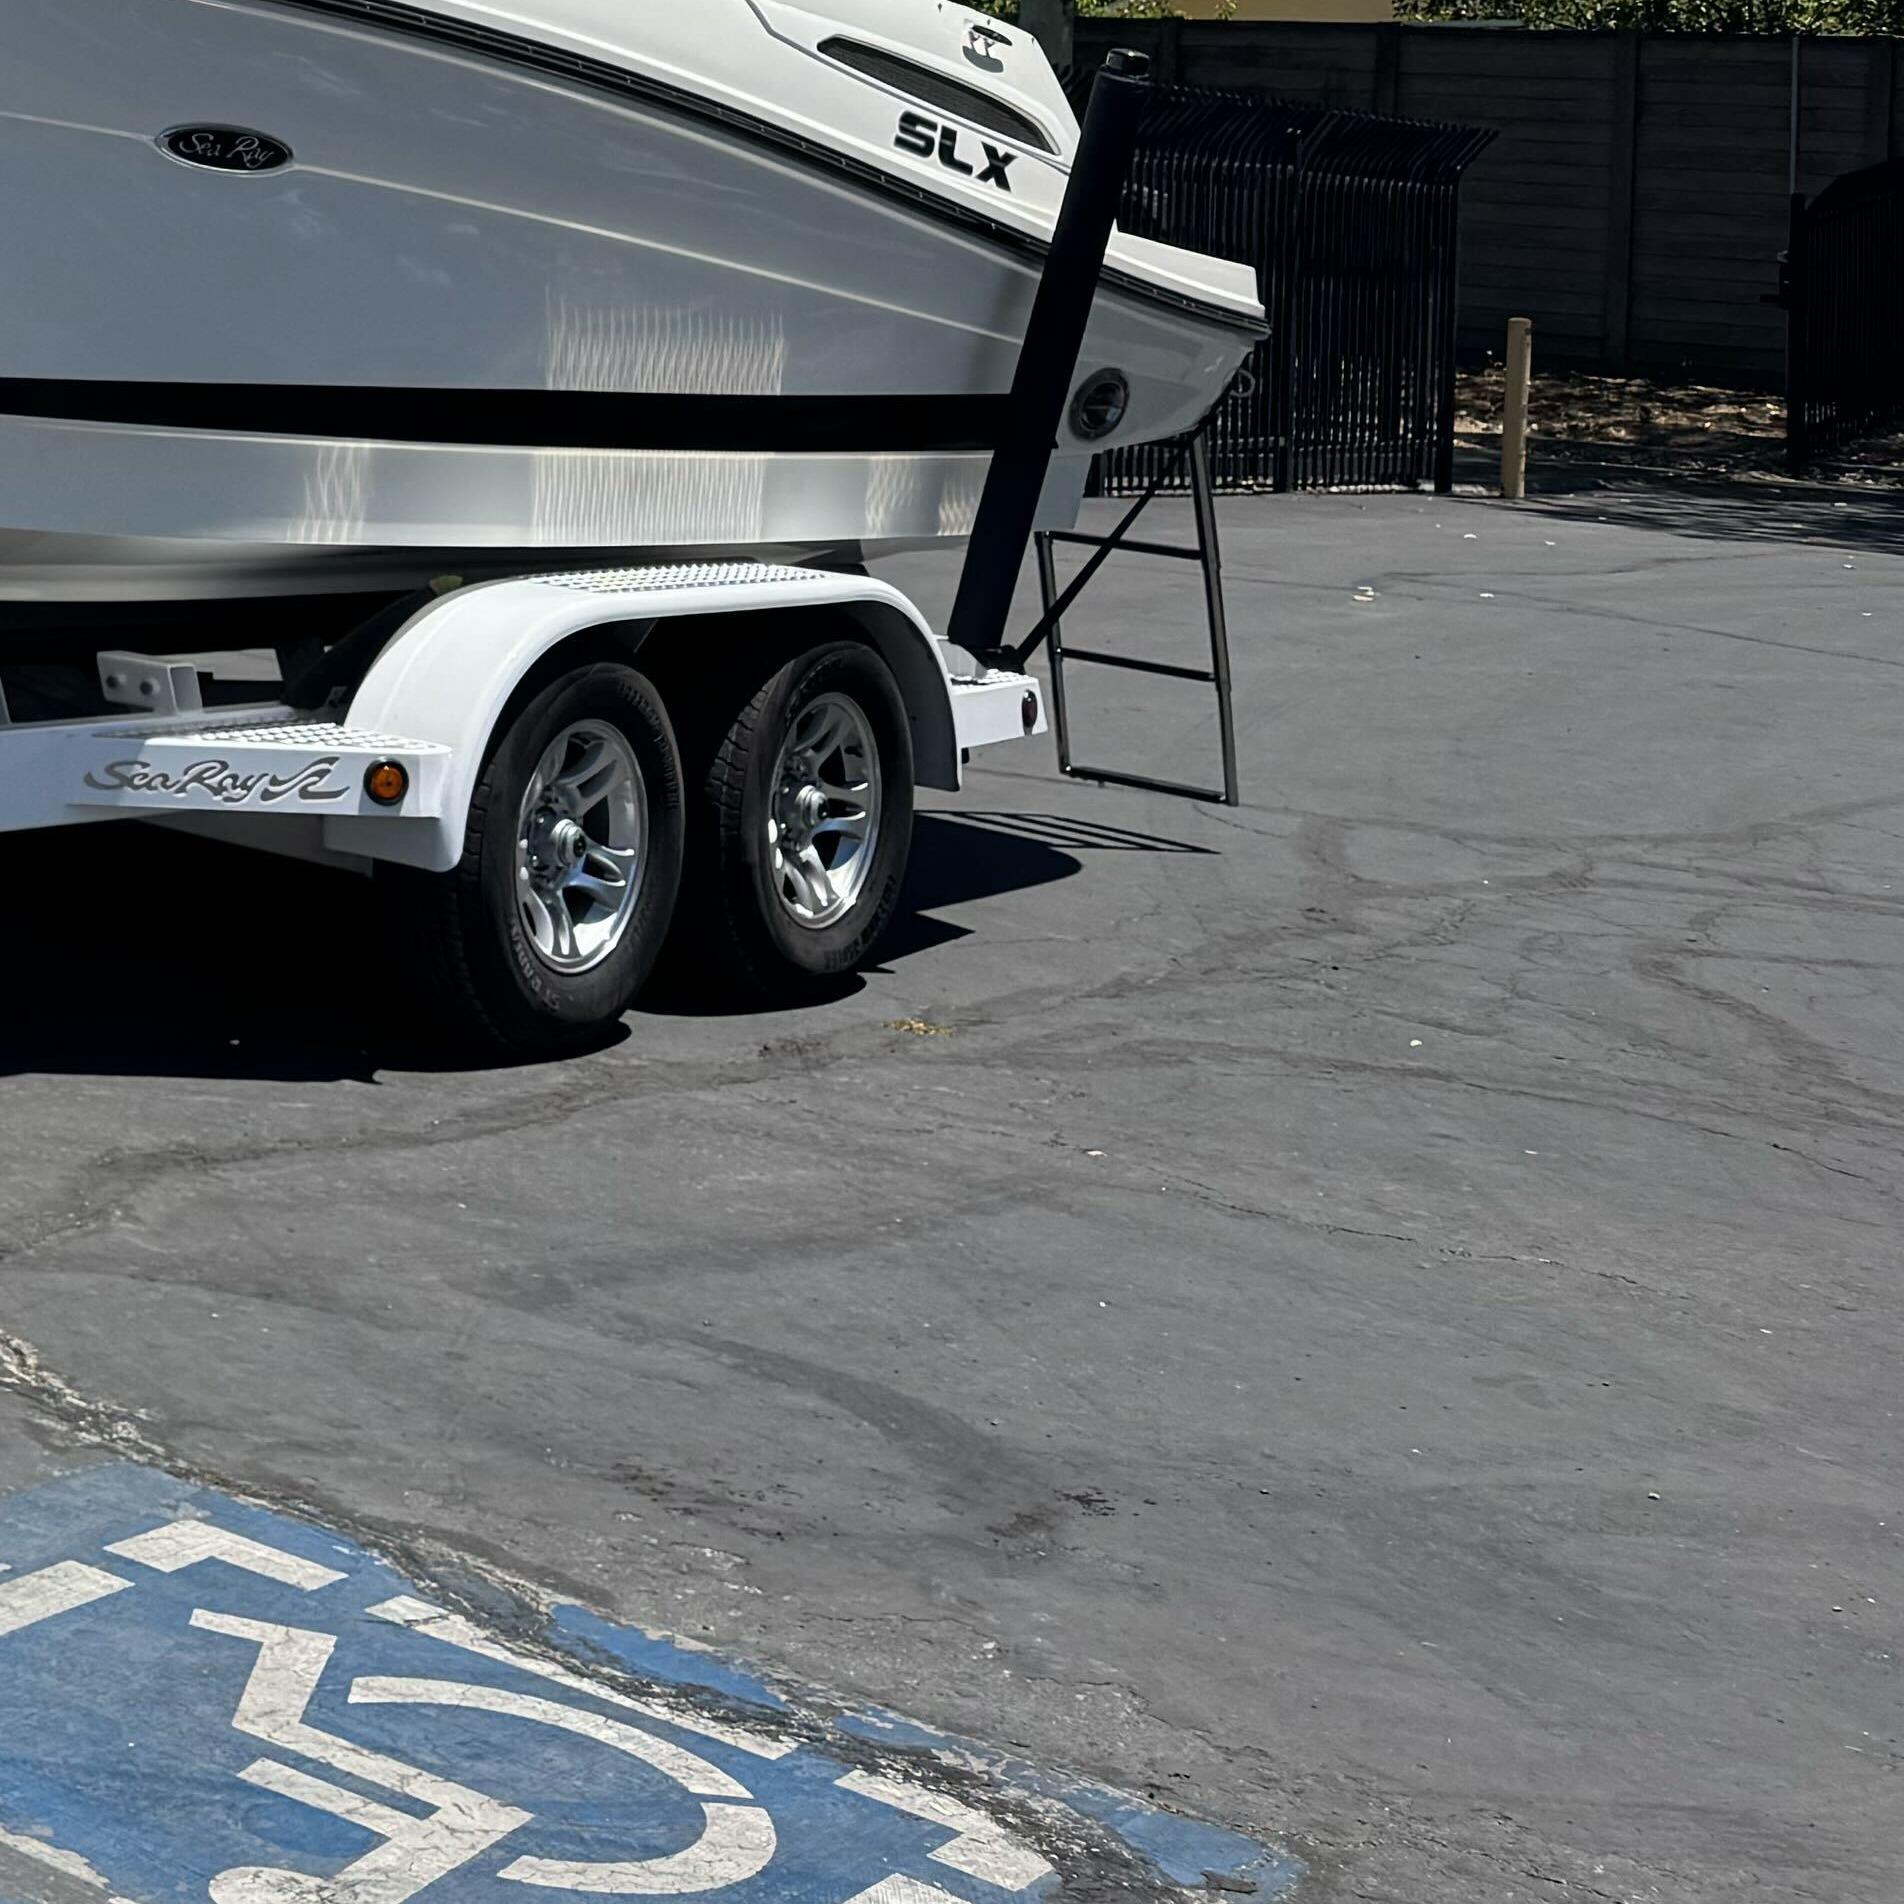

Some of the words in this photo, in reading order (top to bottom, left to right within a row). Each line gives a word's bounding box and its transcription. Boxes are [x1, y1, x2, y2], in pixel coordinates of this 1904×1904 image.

[179, 132, 223, 157] Sea
[225, 135, 276, 169] Ray
[894, 110, 1016, 193] SLX
